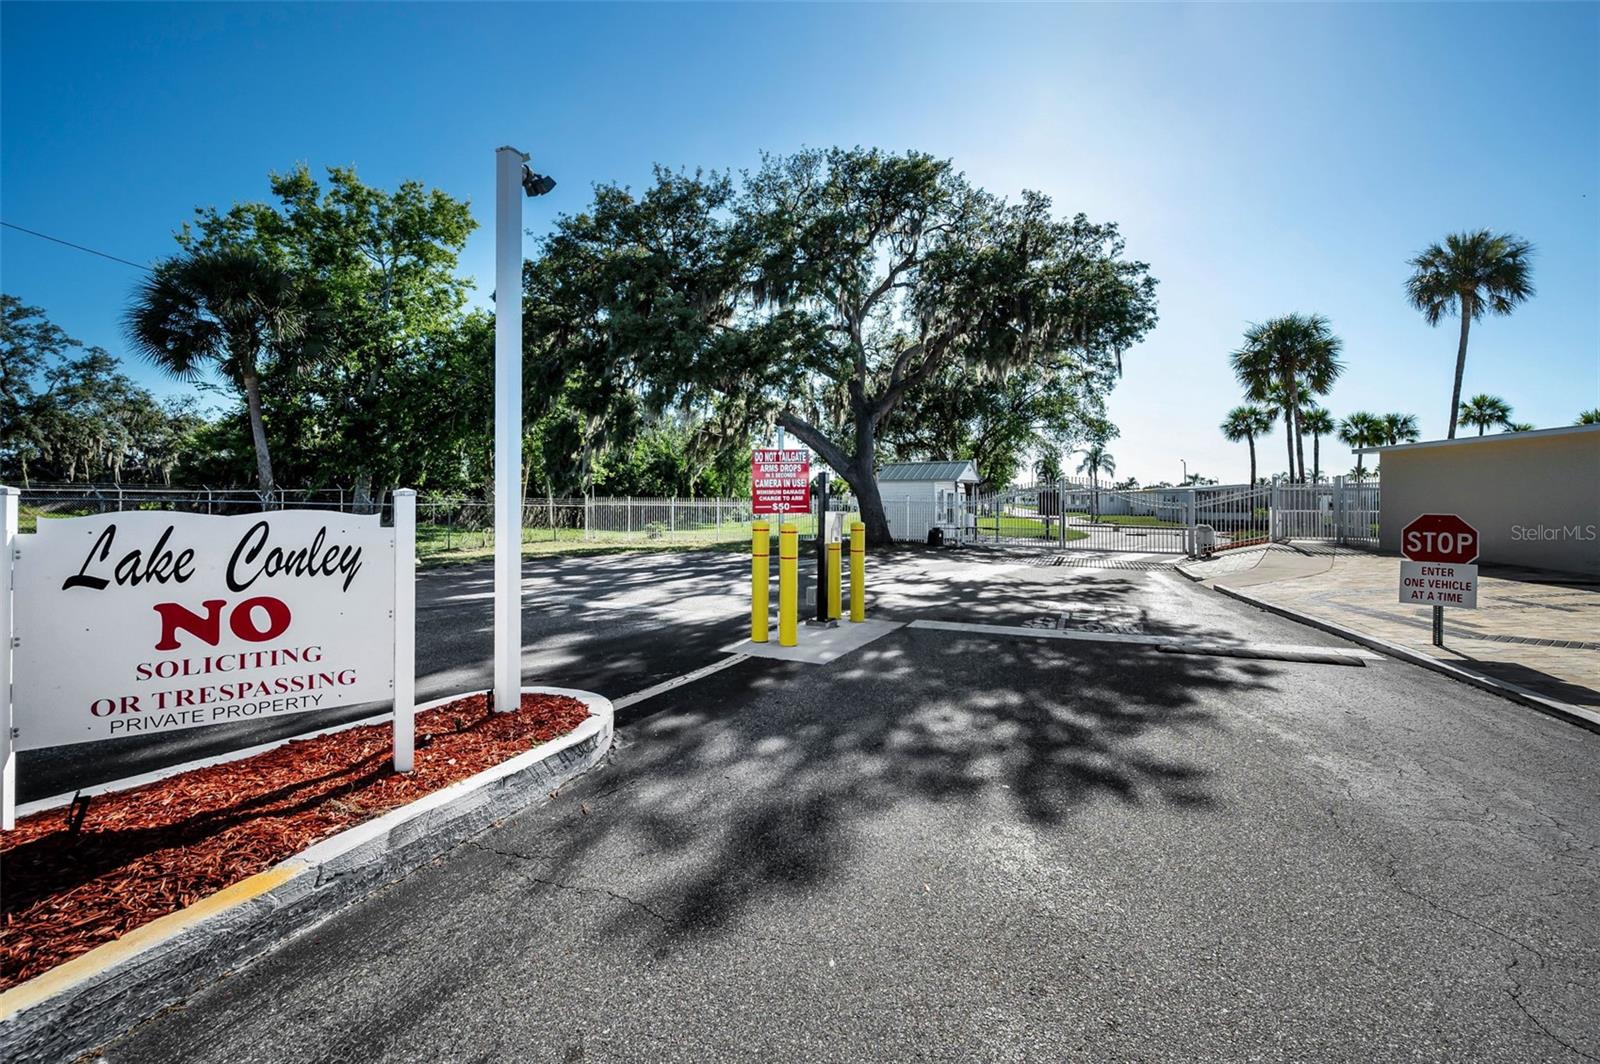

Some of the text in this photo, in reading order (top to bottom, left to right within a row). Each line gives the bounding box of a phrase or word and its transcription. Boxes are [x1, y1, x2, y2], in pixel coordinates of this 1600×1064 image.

[755, 452, 806, 462] DO NOT TAILGATE
[62, 520, 362, 593] Lake Conley
[1407, 531, 1473, 554] STOP
[1404, 578, 1472, 592] ONE VEHICLE
[1422, 566, 1454, 577] ENTER
[1411, 591, 1463, 603] AT A TIME
[153, 596, 292, 651] NO
[136, 645, 322, 682] SOLICITING
[90, 668, 357, 718] OR TRESPASSING
[110, 694, 324, 734] PRIVATE PROPERTY
